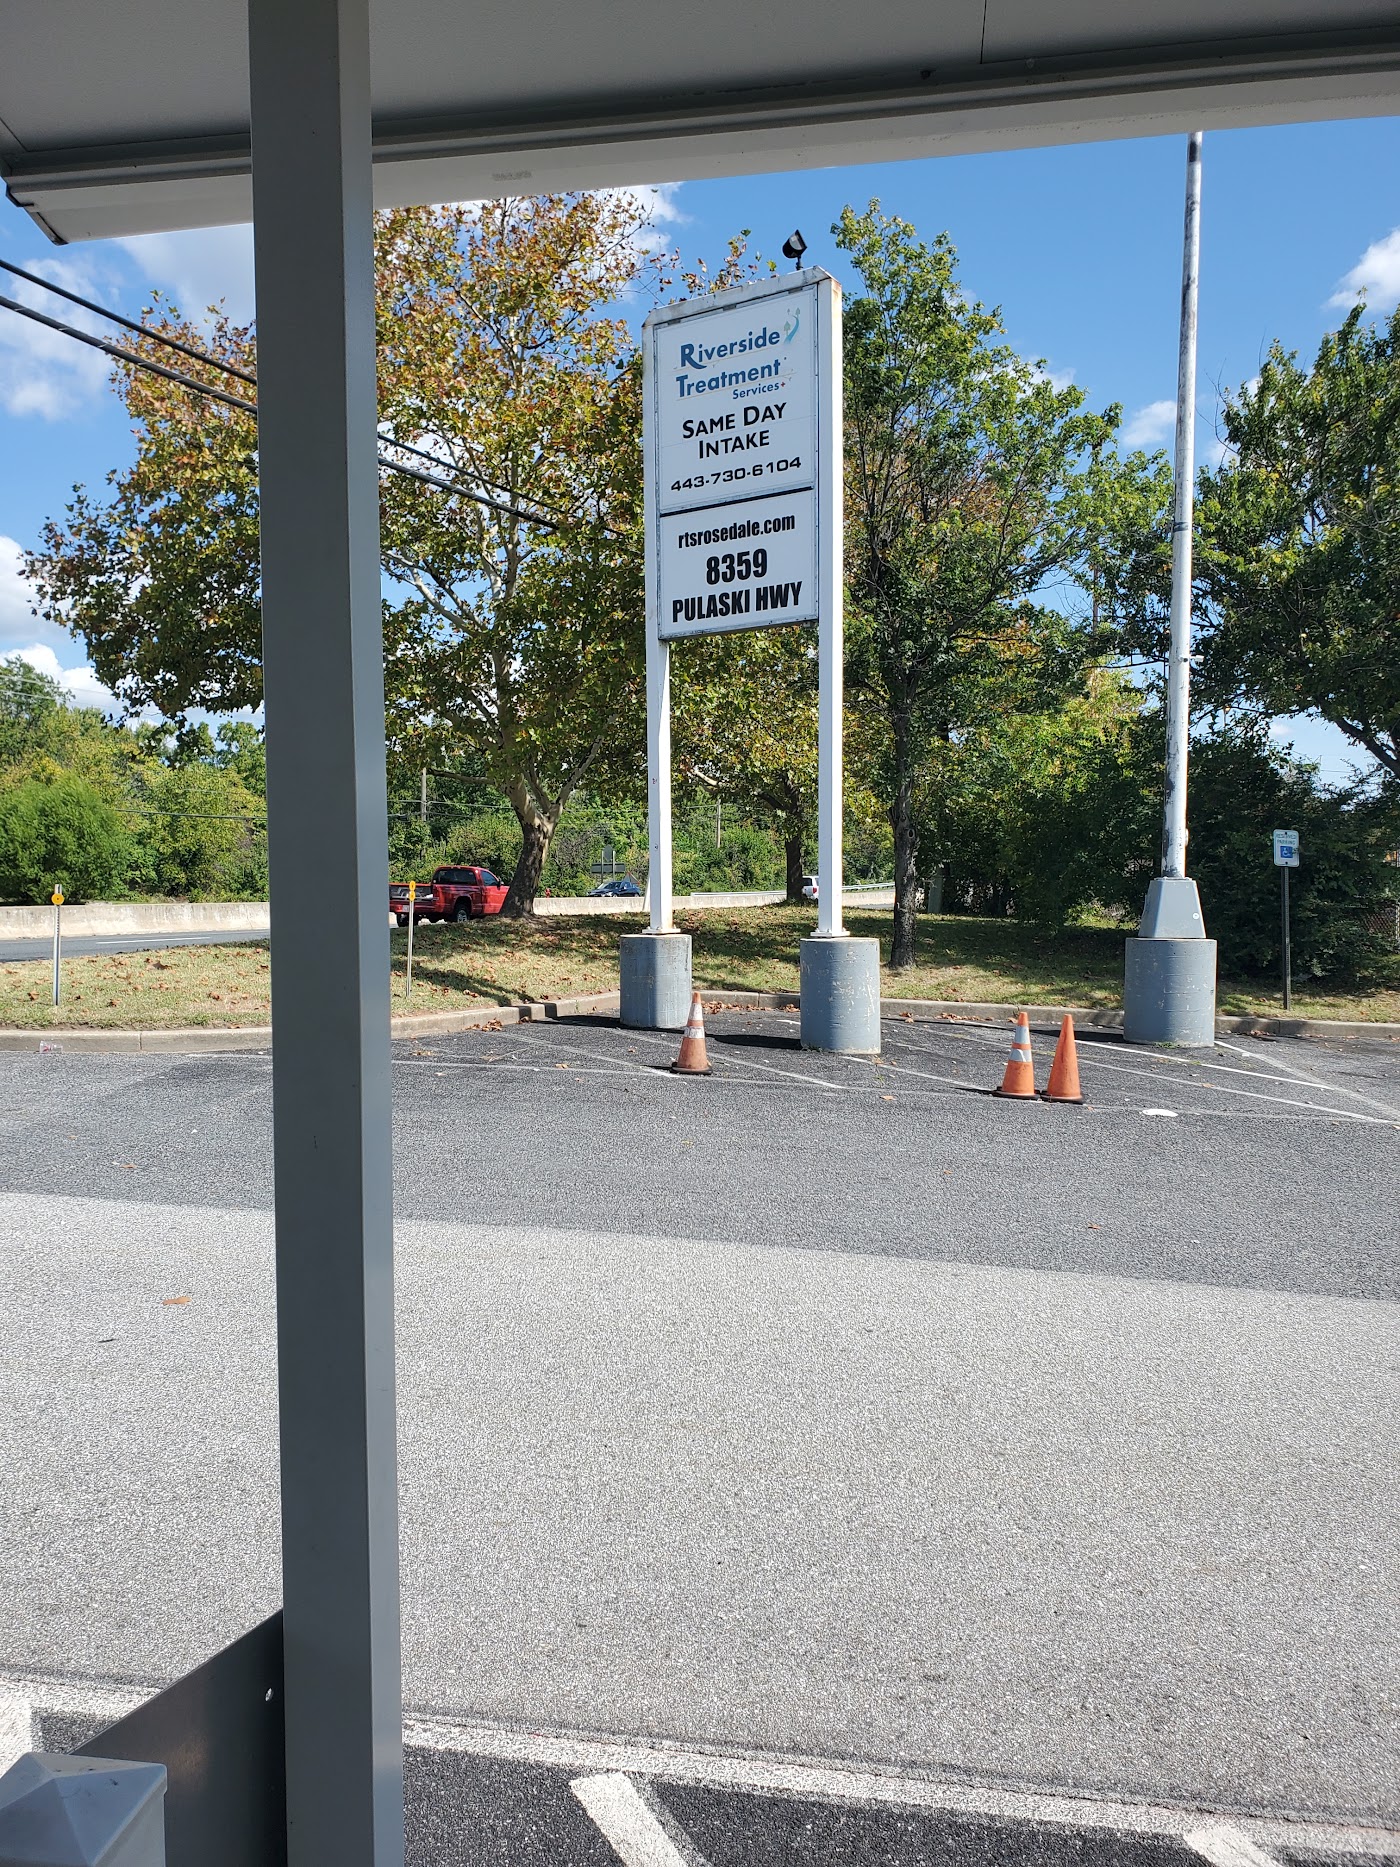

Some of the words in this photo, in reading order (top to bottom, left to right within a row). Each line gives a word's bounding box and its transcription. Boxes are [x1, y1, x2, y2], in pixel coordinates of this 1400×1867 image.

[680, 327, 780, 369] Riverside
[676, 359, 781, 397] Treatment
[682, 413, 735, 439] SAME
[743, 402, 787, 427] DAY
[699, 430, 770, 459] INTAKE
[678, 515, 795, 549] rtsrosedale.com
[706, 548, 768, 585] 8359
[672, 589, 750, 623] PULASKI
[755, 581, 802, 612] HWY
